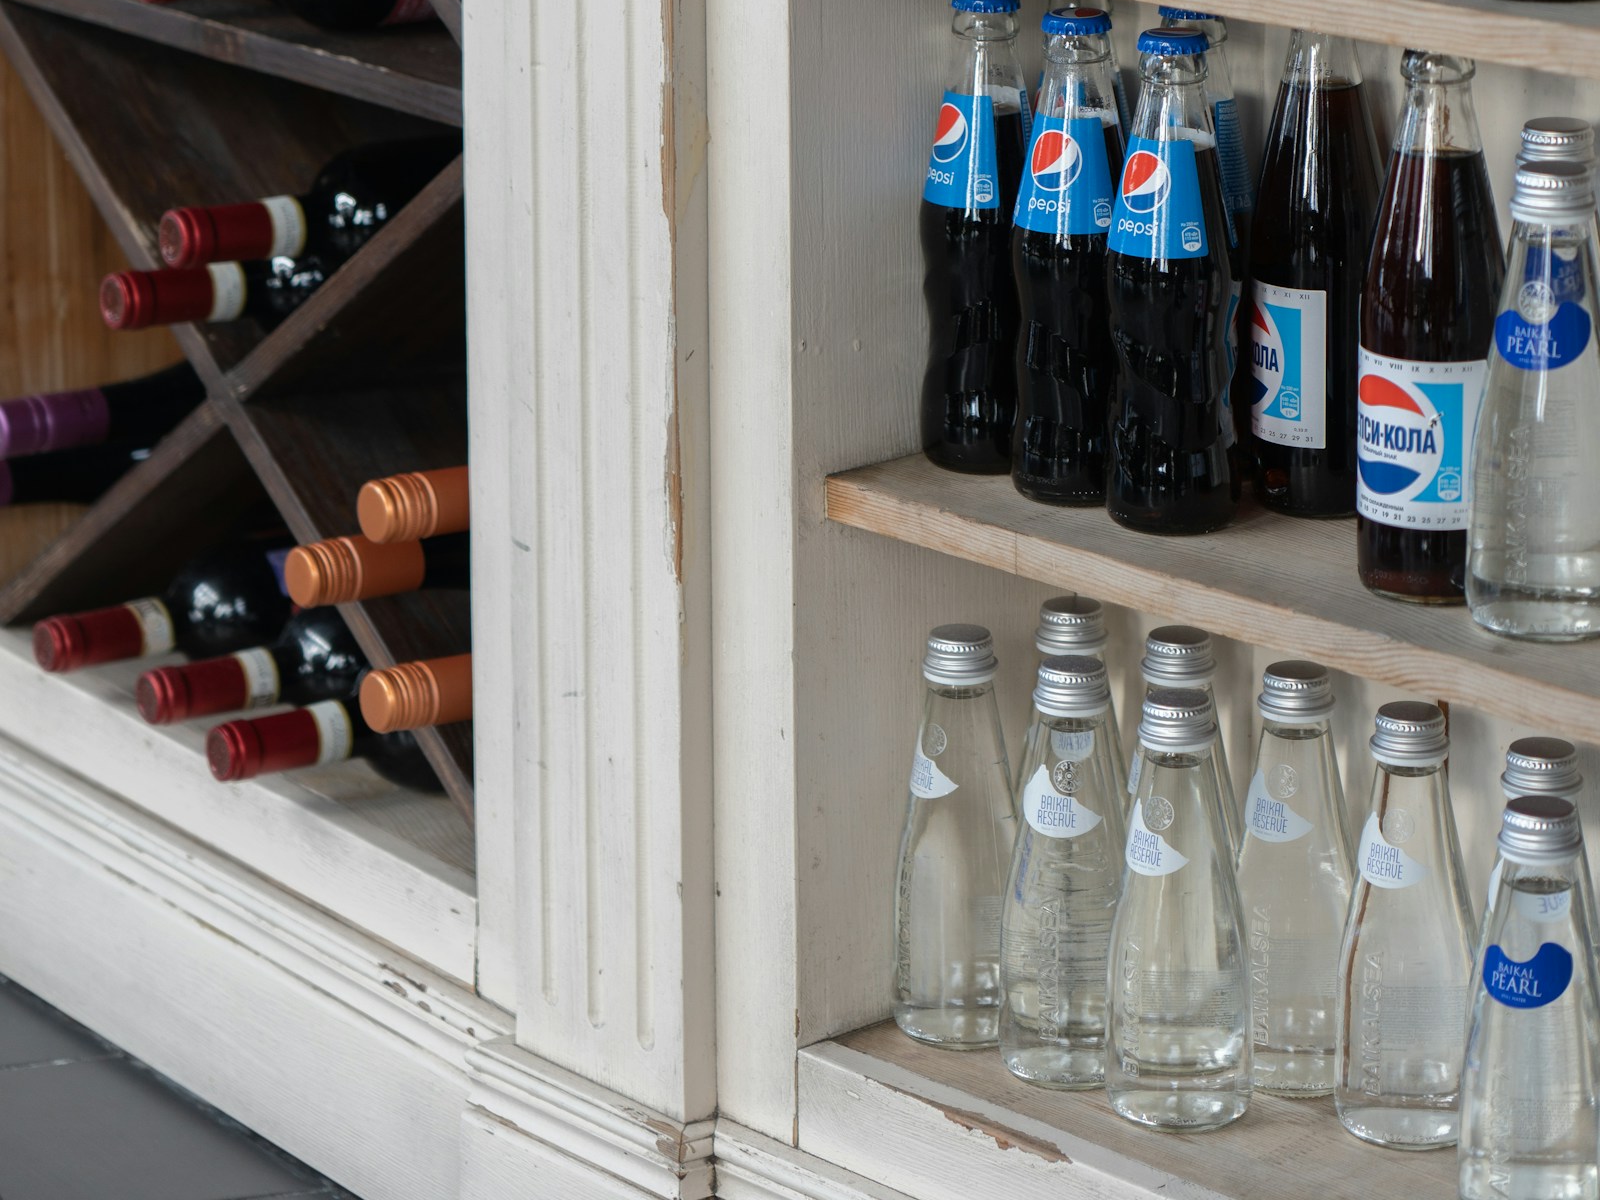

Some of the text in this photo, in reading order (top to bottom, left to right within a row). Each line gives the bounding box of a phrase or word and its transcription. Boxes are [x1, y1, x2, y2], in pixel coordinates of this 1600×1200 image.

[1028, 197, 1072, 215] pepsi
[1118, 218, 1159, 237] pepsi
[1515, 326, 1554, 341] BAIKAL
[1507, 336, 1562, 359] PEARL
[1390, 362, 1403, 371] VIII
[1422, 516, 1431, 524] 25
[1040, 794, 1075, 813] BAIKAL
[1255, 797, 1287, 819] BAIKAL
[1037, 809, 1078, 829] RESERVE
[1252, 812, 1289, 834] RESERVE
[1134, 828, 1160, 851] BAIKAL
[1130, 843, 1164, 867] RESERVE
[1370, 842, 1401, 864] BAIKAL
[1366, 857, 1404, 880] RESERVE
[1041, 898, 1060, 1041] BAIKALSEA
[1252, 904, 1272, 1046] BAIKALSEA
[1498, 961, 1535, 980] BAIKAL
[1491, 970, 1543, 998] PEARL
[1362, 950, 1384, 1097] BAIKALSEA
